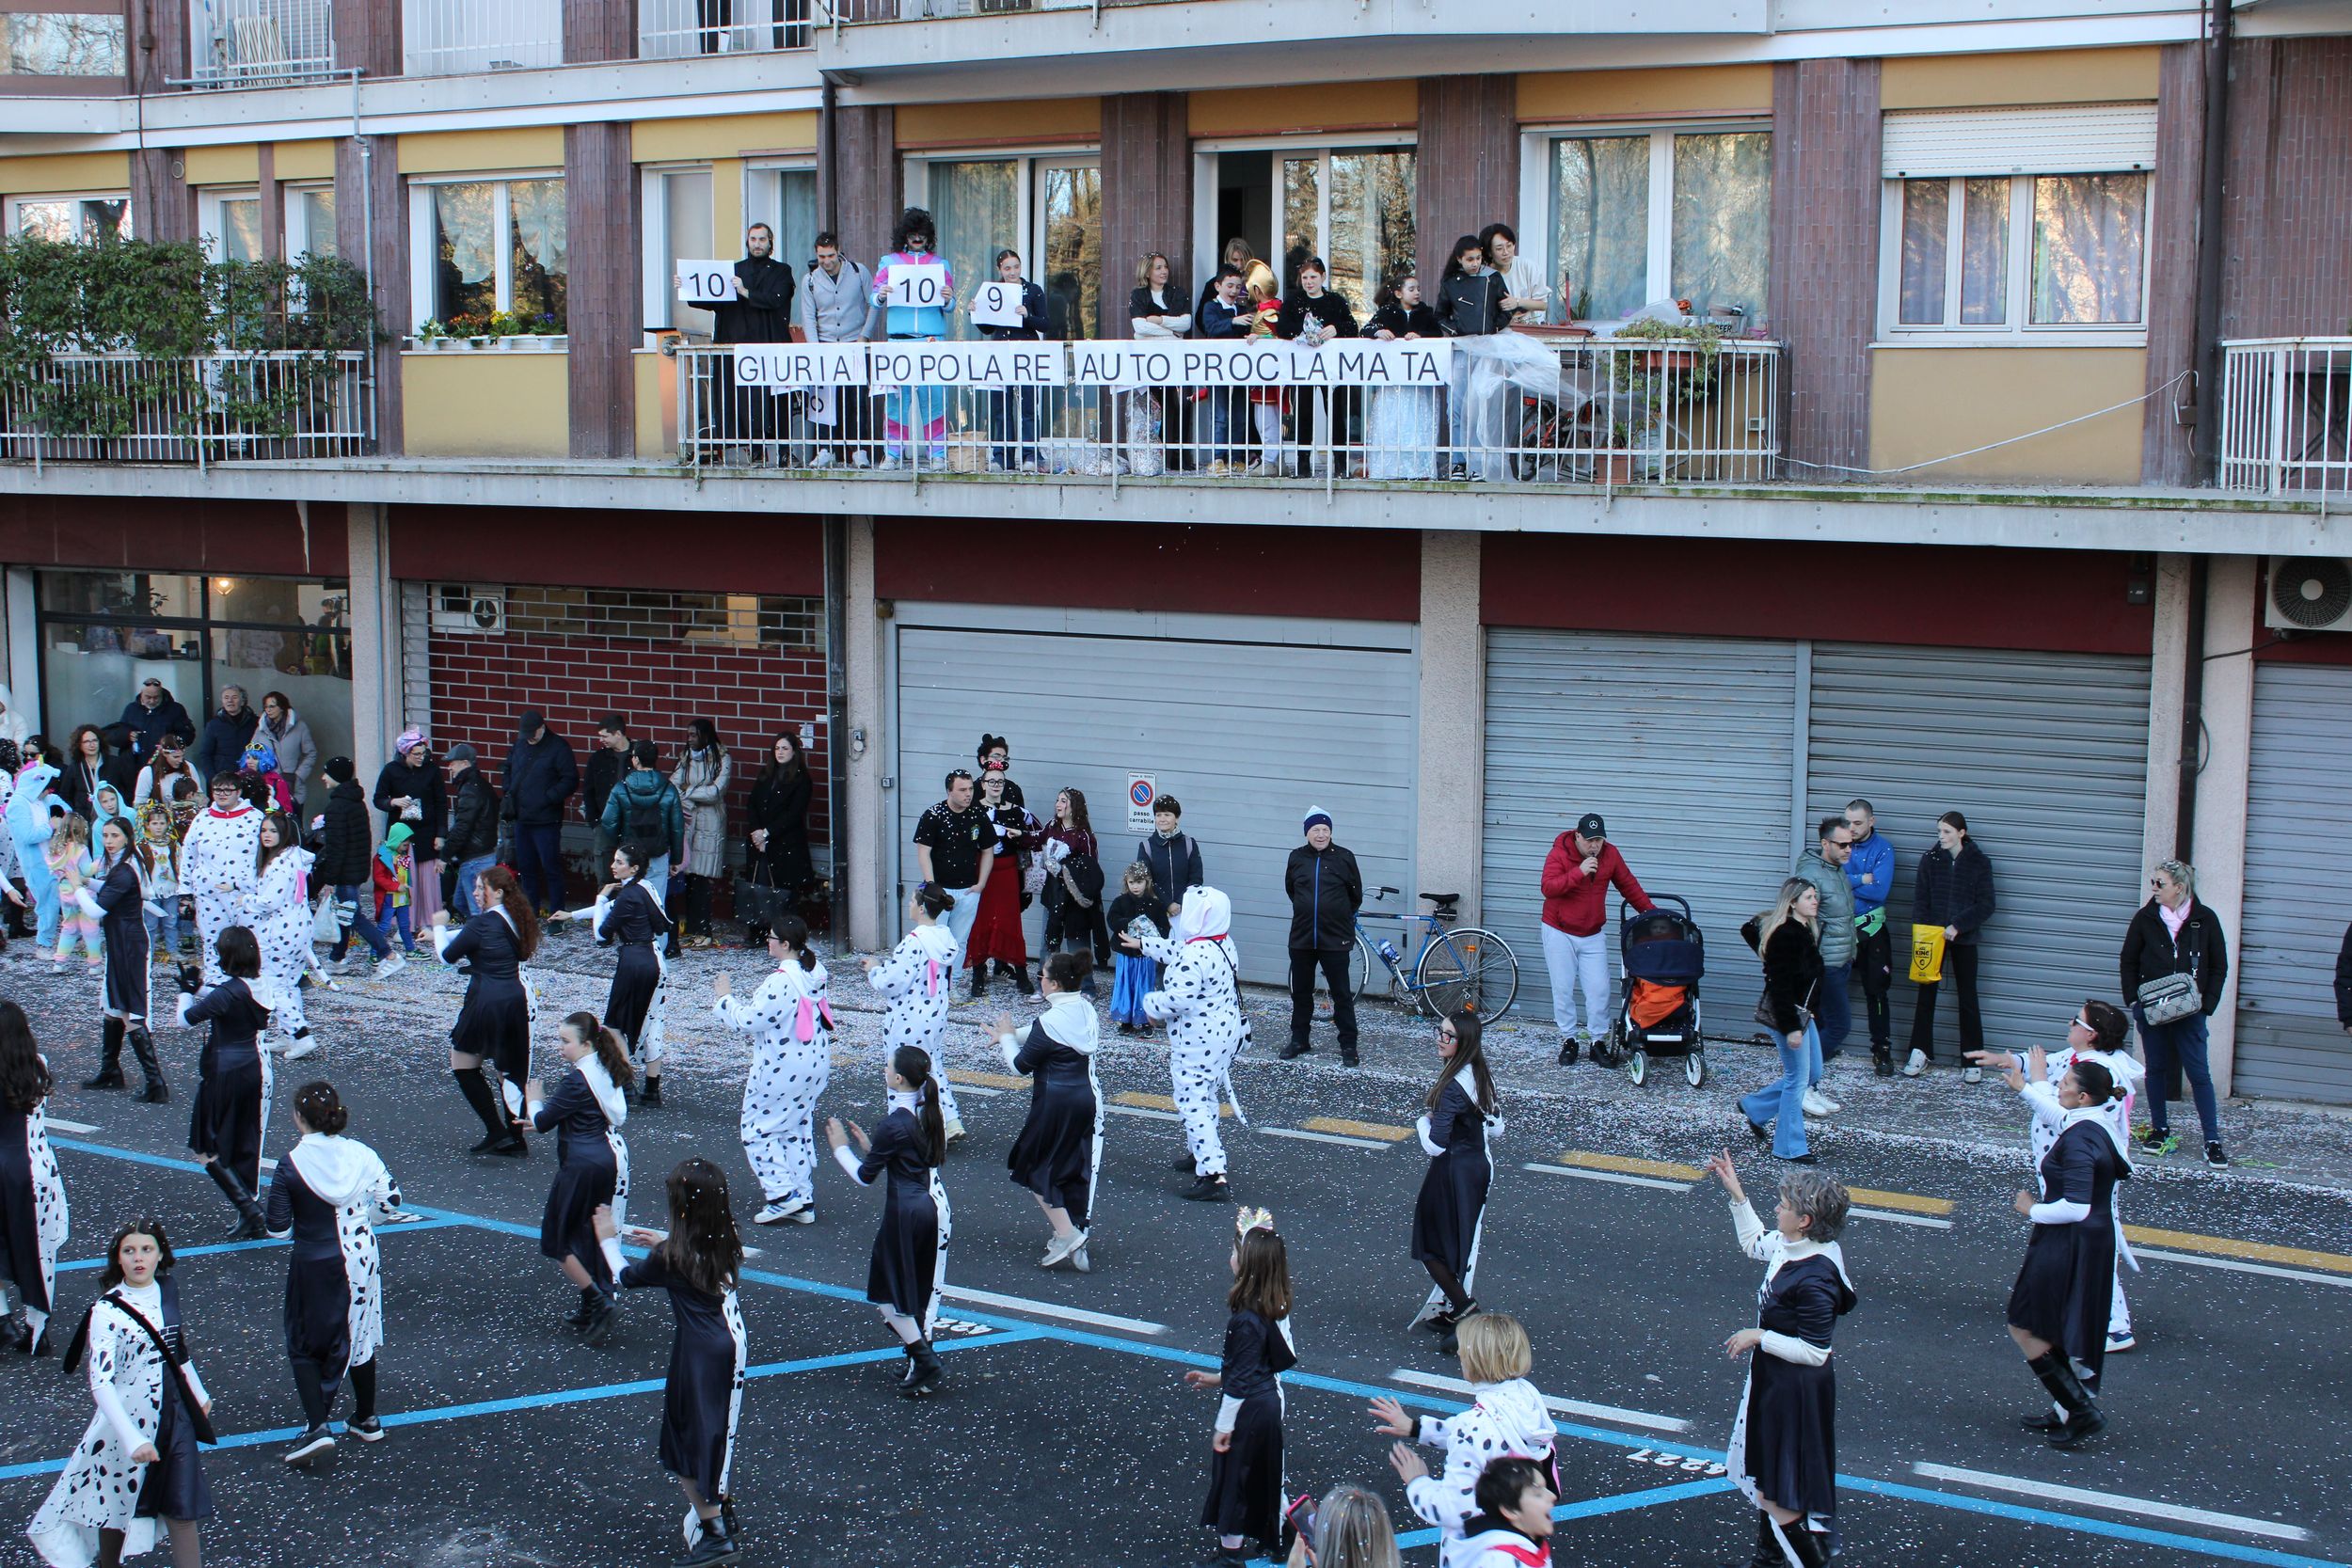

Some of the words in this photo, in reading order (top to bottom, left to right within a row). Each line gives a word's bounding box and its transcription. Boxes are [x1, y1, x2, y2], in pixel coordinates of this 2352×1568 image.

[689, 272, 725, 297] 10
[899, 278, 935, 304] 10
[987, 286, 1003, 312] 9
[738, 356, 851, 382] GIURIA
[875, 353, 1051, 382] POPOLARE
[931, 1317, 993, 1335] 422
[1626, 1448, 1727, 1475] 4227
